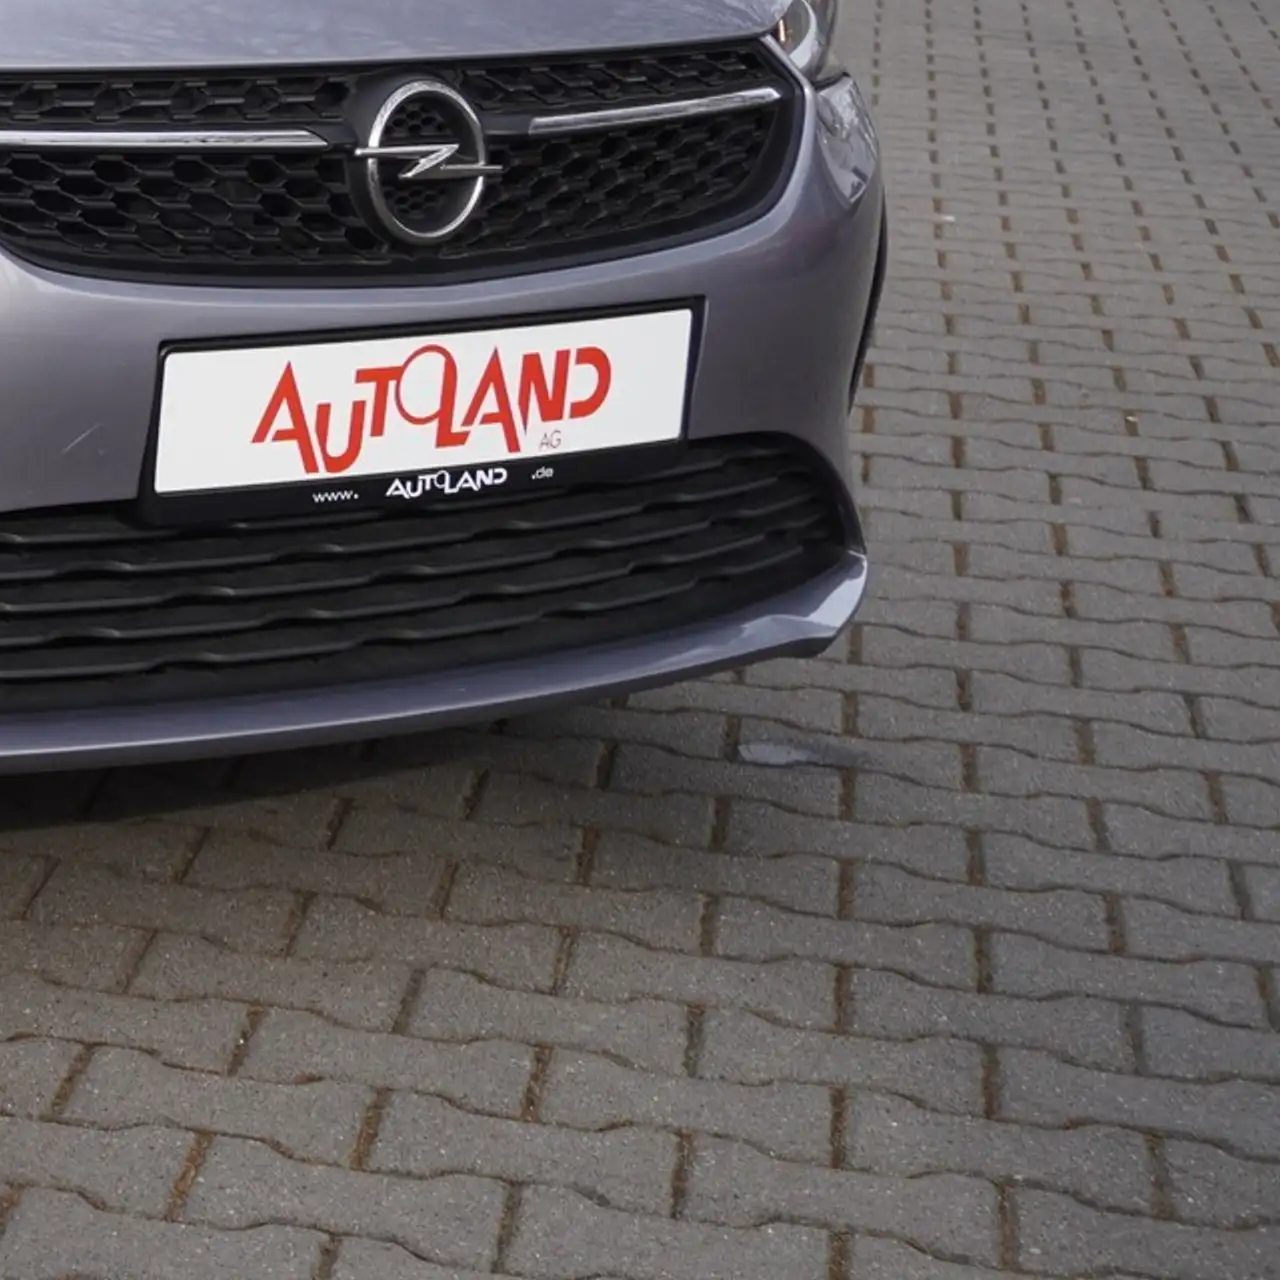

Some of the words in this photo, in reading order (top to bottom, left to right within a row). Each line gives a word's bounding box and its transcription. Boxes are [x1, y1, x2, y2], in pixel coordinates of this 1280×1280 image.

[539, 429, 562, 449] AG
[312, 489, 360, 504] www.
[530, 466, 555, 481] .de
